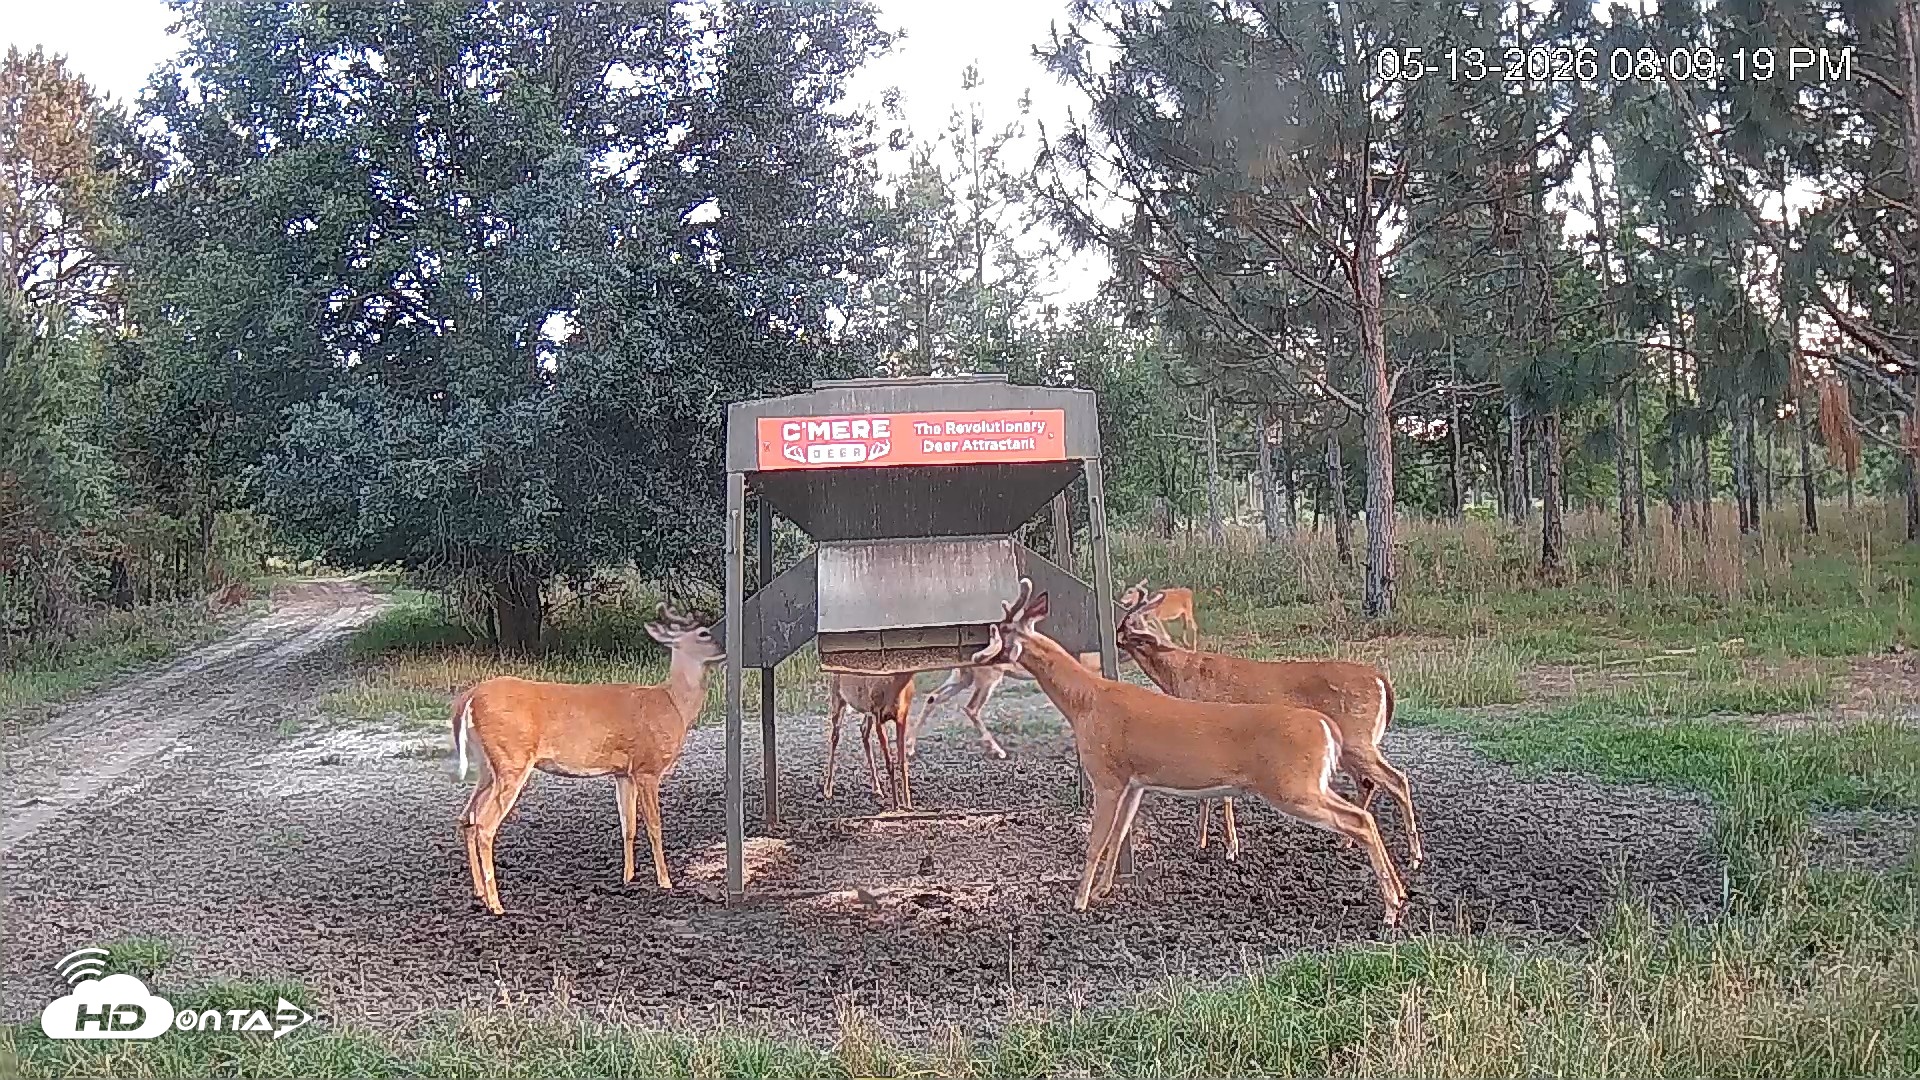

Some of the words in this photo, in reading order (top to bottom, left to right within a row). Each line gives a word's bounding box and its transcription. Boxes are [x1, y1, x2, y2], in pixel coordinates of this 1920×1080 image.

[782, 419, 891, 441] C'MERE
[913, 422, 942, 435] The
[944, 420, 1046, 435] Revolutionary
[922, 439, 958, 453] Deer
[961, 438, 1036, 451] Attractant
